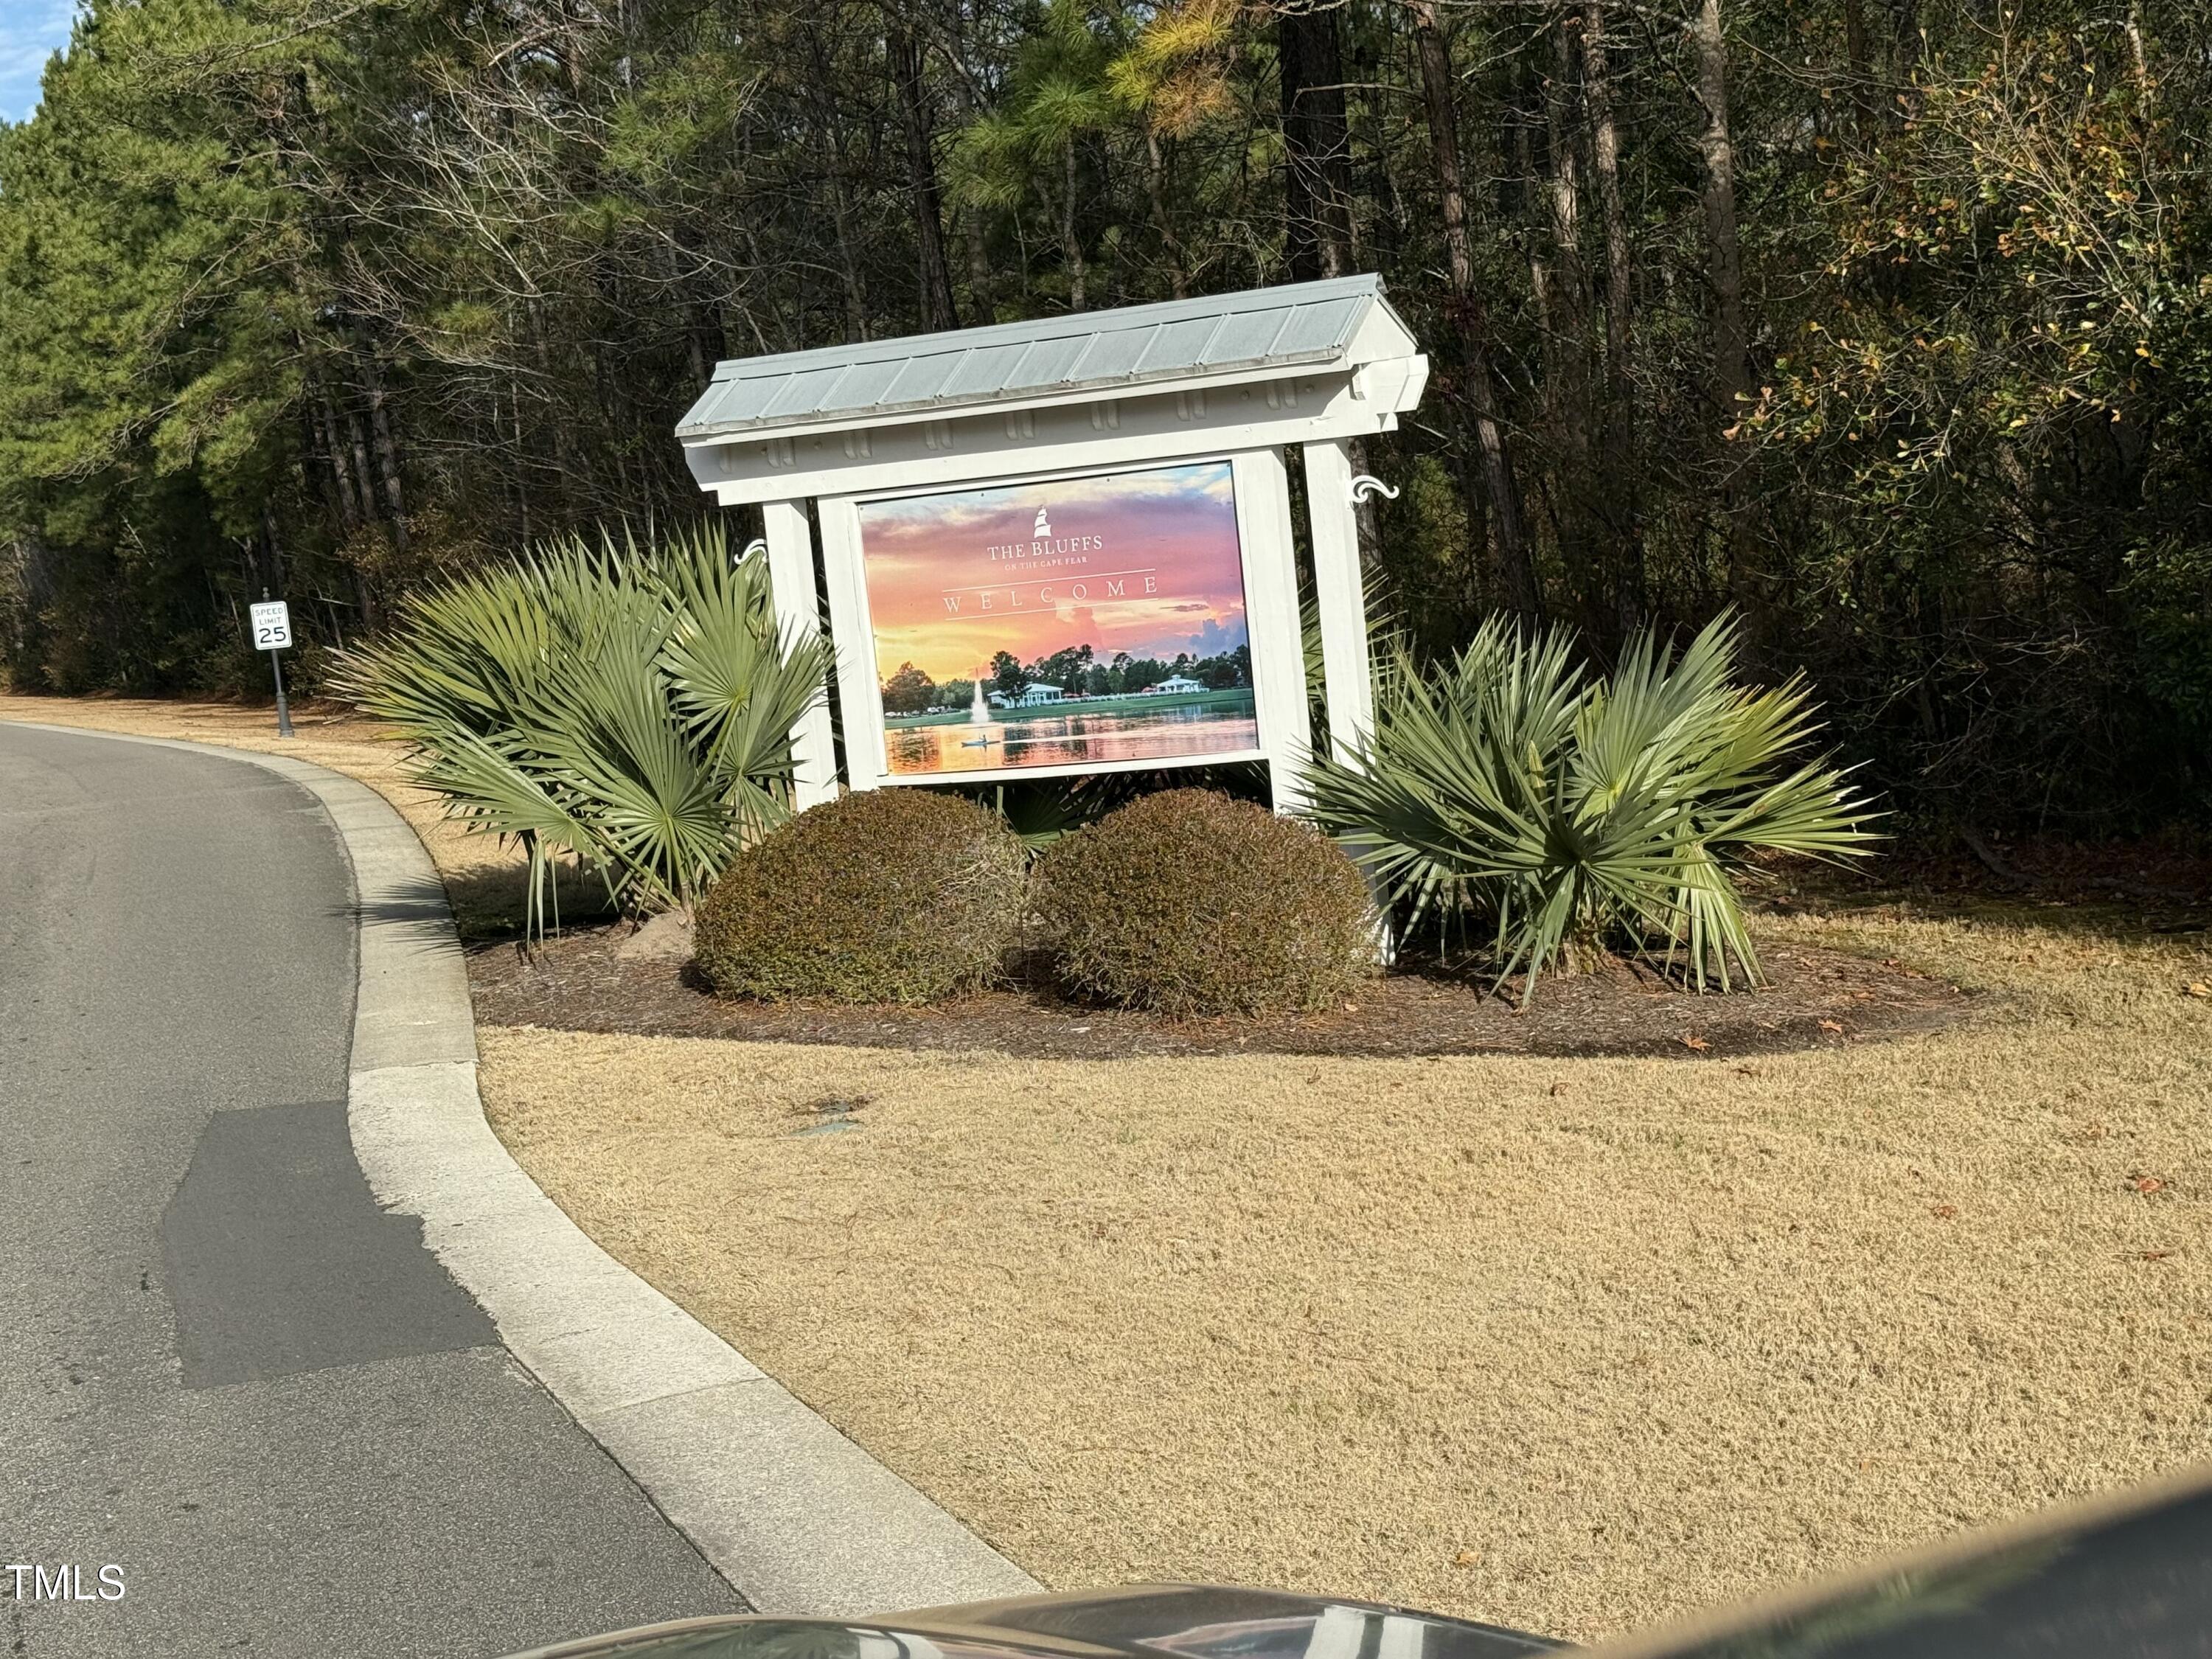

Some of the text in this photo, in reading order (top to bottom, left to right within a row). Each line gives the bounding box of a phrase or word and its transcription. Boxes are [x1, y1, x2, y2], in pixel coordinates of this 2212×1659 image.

[987, 535, 1104, 561] THE BLUFFS
[1020, 561, 1037, 570] THE
[1040, 559, 1062, 568] CAPE
[1065, 556, 1088, 565] FEAR
[943, 577, 1158, 613] WELCOME
[254, 607, 284, 616] SPEED
[259, 616, 282, 625] LIMIT
[259, 626, 286, 643] 25
